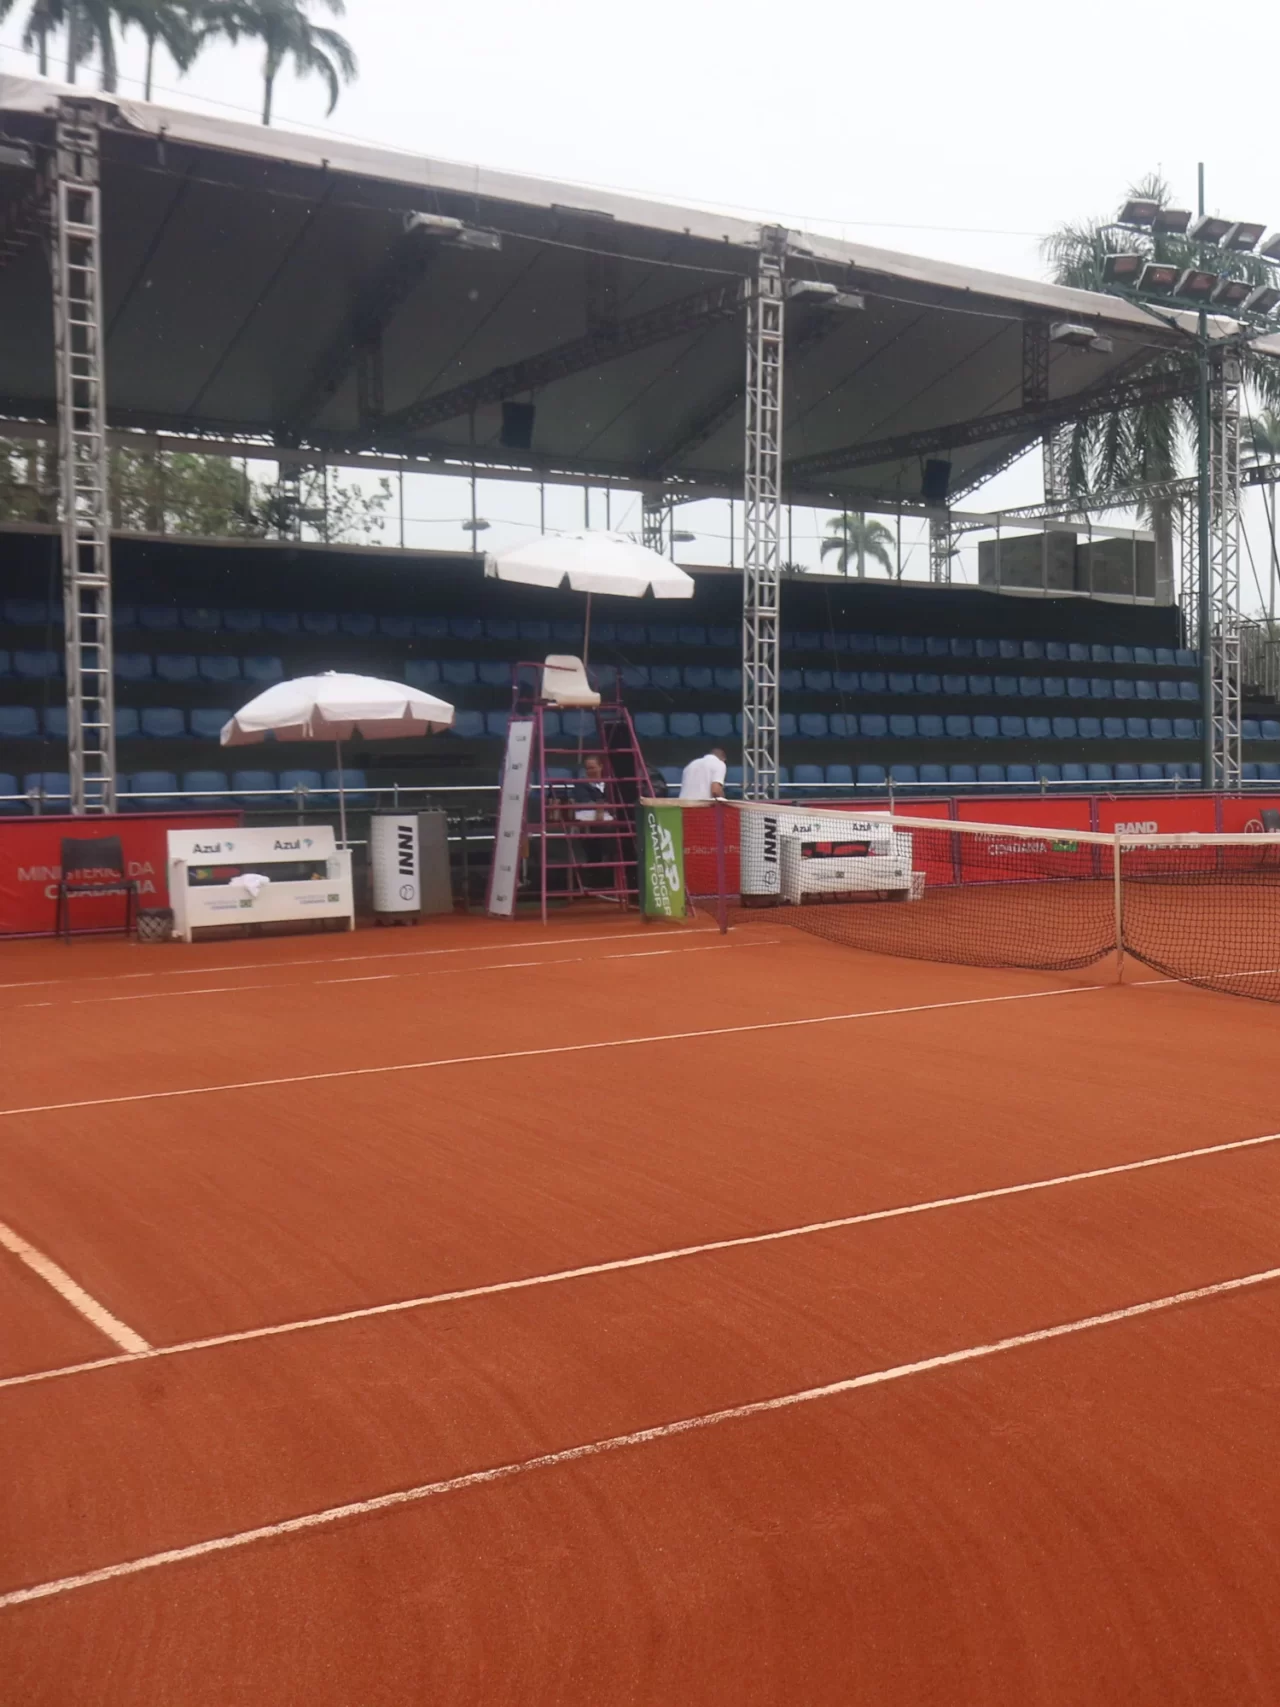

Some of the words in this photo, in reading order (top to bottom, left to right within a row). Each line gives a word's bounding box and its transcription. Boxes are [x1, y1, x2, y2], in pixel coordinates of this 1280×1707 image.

[193, 843, 221, 854] Azul
[274, 839, 300, 851] Azul
[397, 825, 414, 876] INNI
[764, 817, 777, 863] INNI
[1114, 821, 1158, 834] BAND
[129, 861, 154, 876] DA
[647, 812, 672, 916] CHALLENGER
[657, 823, 680, 892] ATP
[649, 862, 662, 909] TOUR
